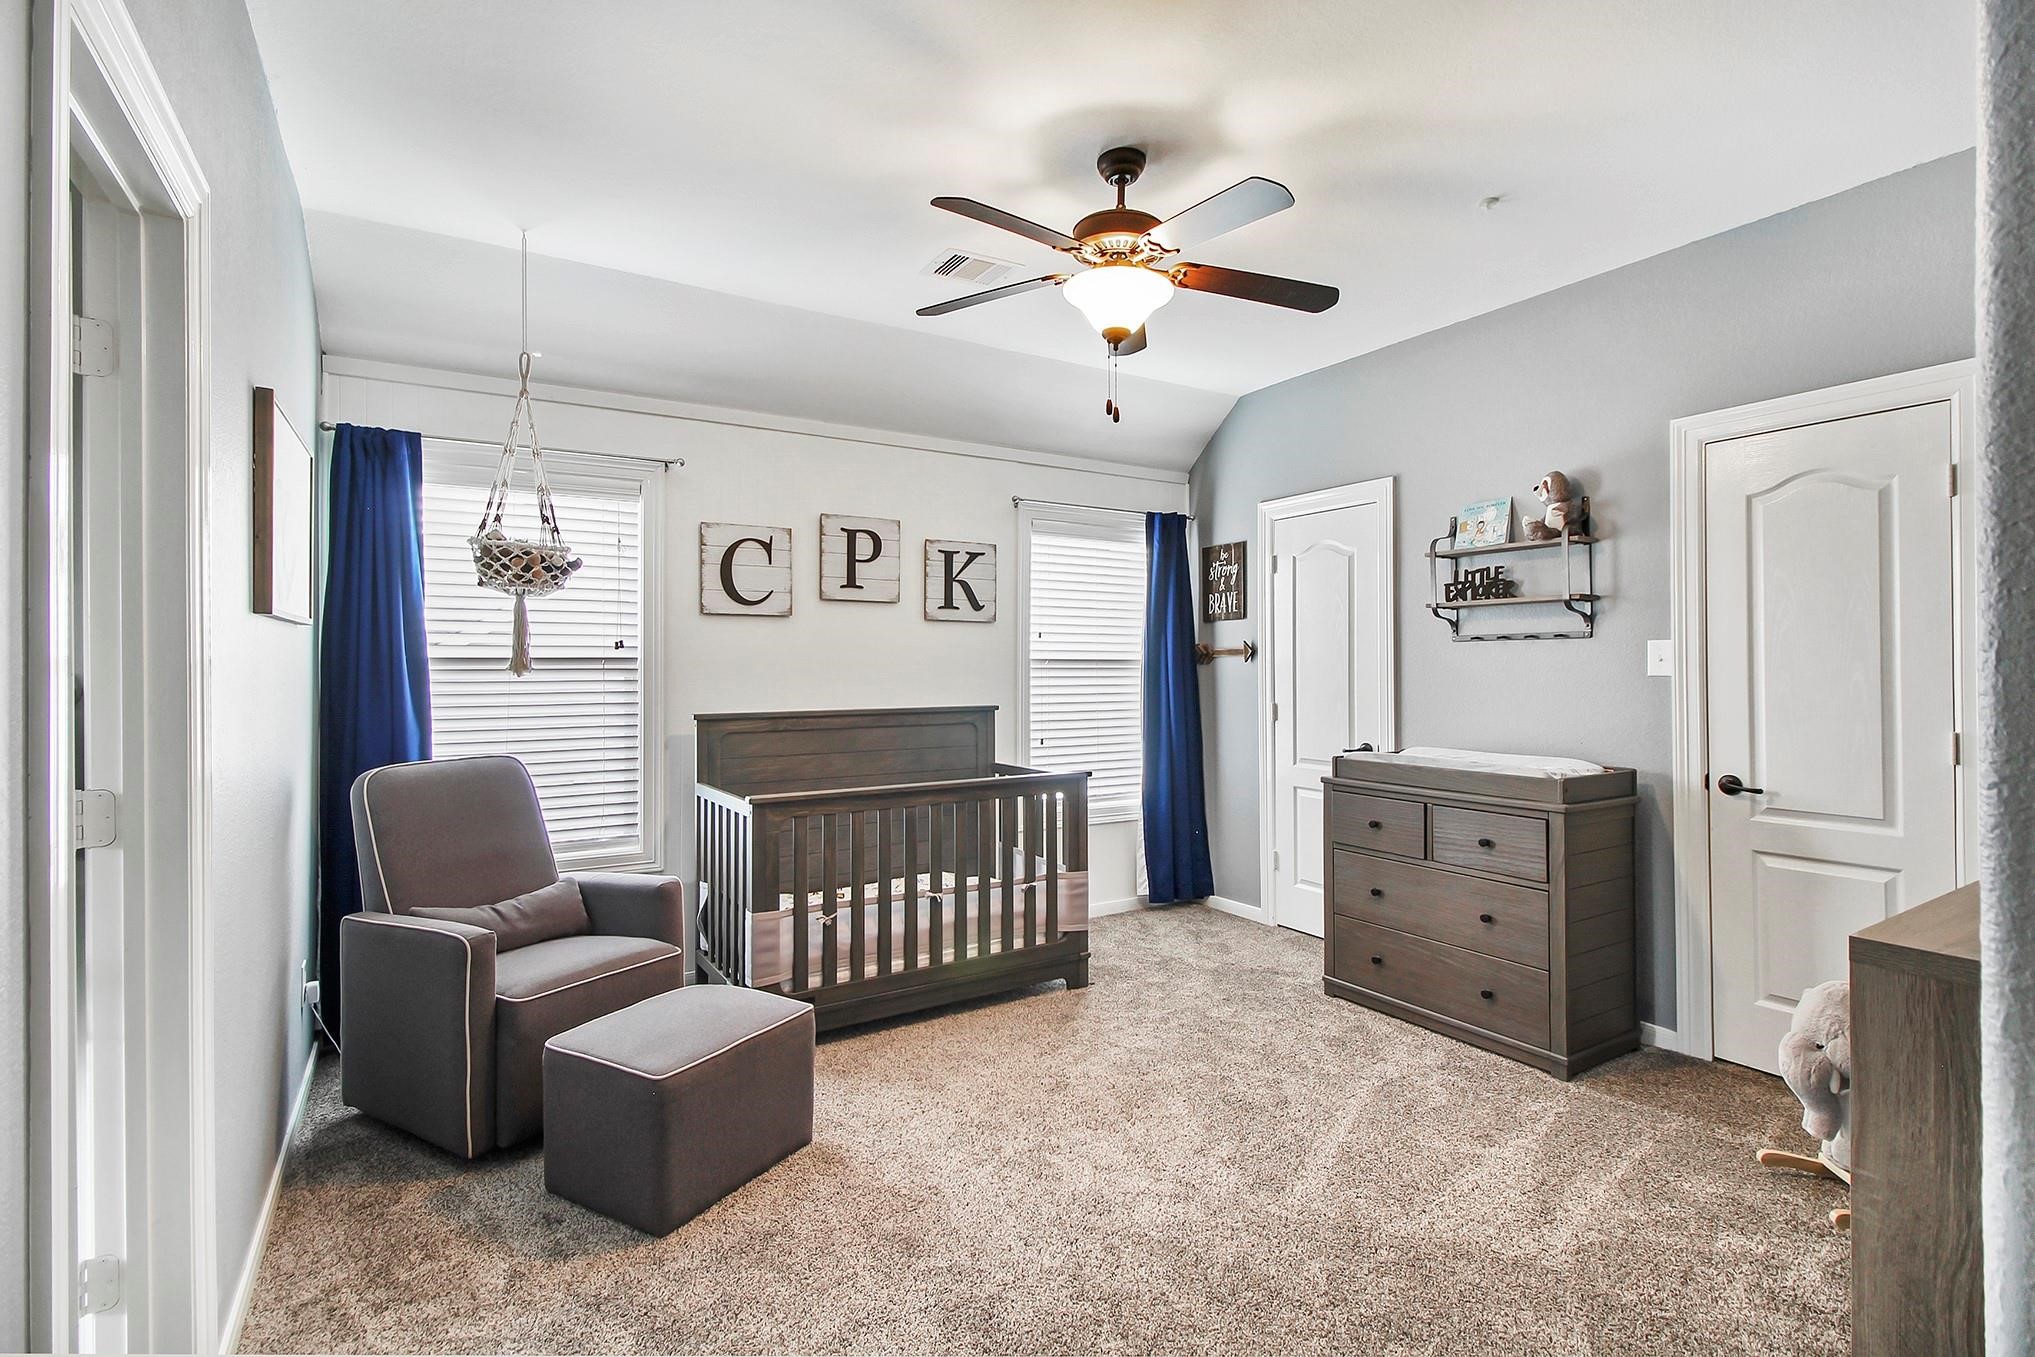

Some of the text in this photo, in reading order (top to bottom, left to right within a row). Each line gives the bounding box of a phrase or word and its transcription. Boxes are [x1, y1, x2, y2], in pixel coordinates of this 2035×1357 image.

[1220, 548, 1229, 560] be
[720, 527, 986, 612] C P K
[1208, 561, 1239, 585] strong
[1453, 566, 1505, 584] LITTLE
[1219, 577, 1226, 591] &
[1208, 591, 1239, 614] BRAVE
